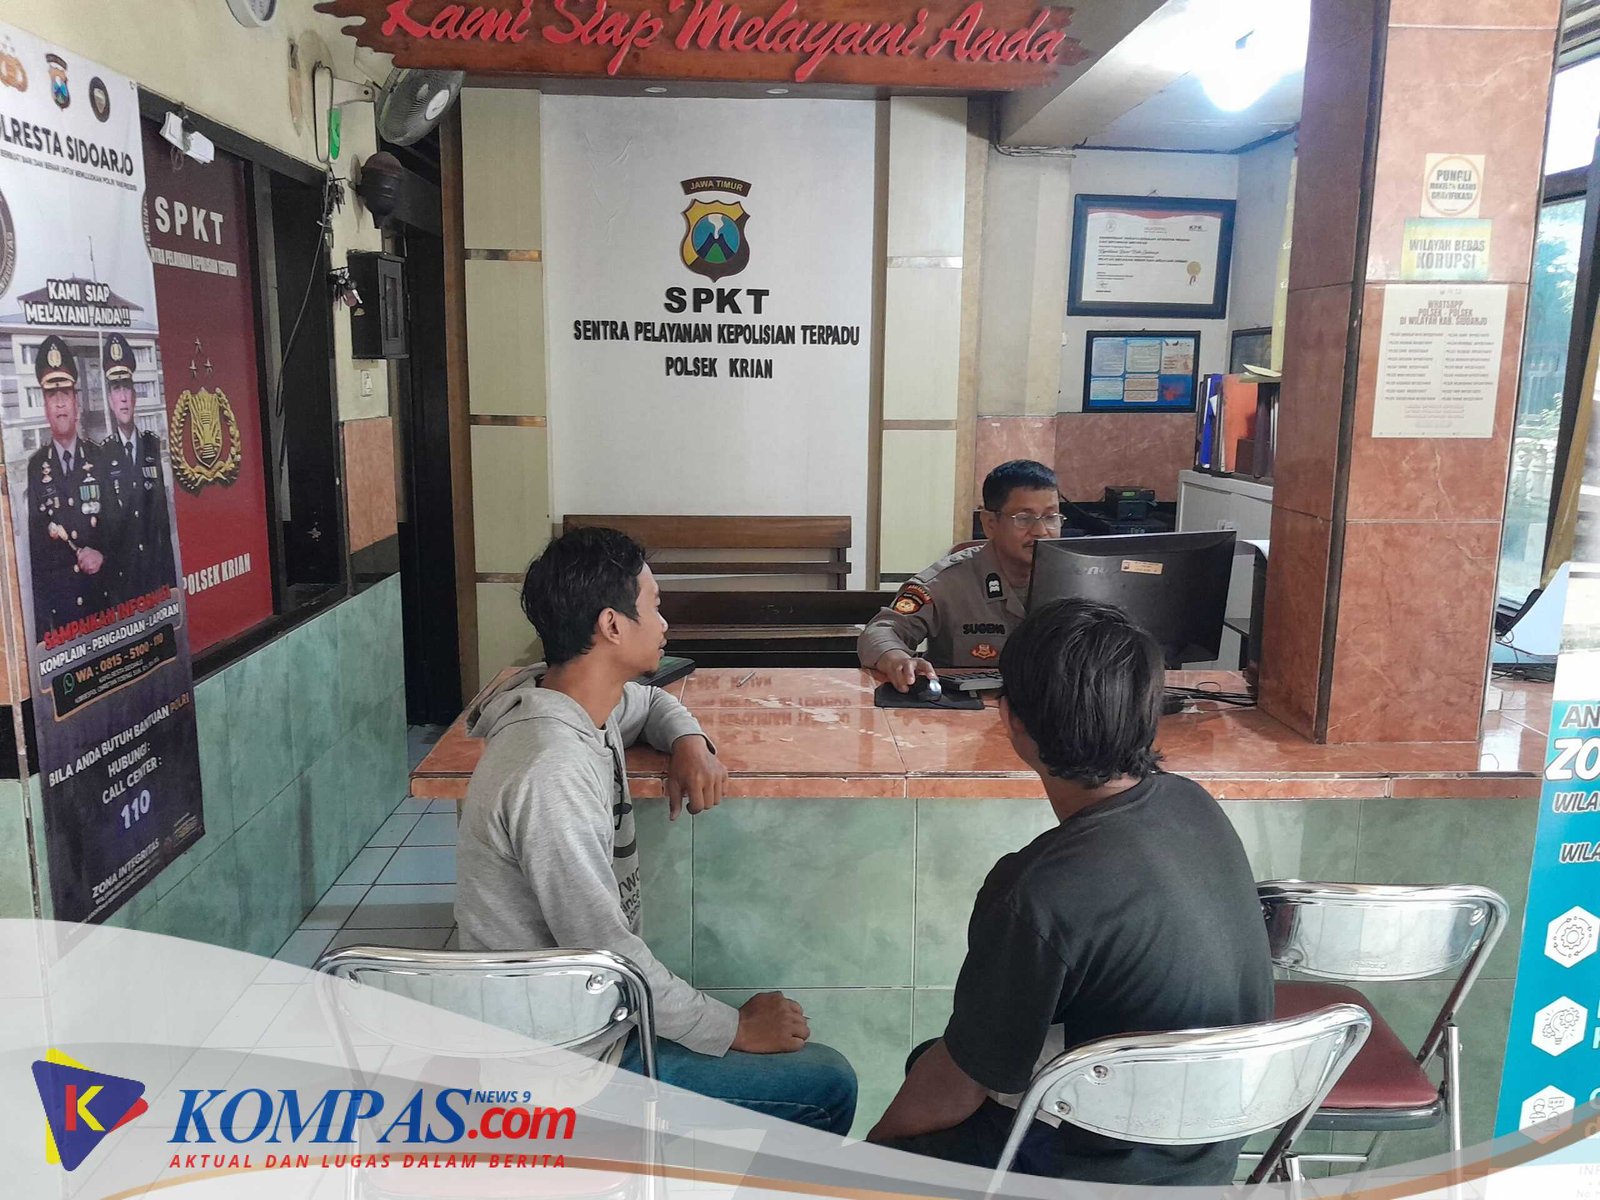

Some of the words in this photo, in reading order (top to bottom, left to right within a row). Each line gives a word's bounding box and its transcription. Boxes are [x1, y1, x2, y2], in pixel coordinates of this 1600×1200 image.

[669, 0, 929, 82] Melayani
[925, 2, 1066, 63] Anda
[0, 113, 64, 158] LRESTA
[65, 135, 135, 177] SIDOARJO
[690, 180, 714, 190] JAWA
[716, 180, 744, 192] TIMUR
[154, 195, 224, 246] SPKT
[1409, 239, 1452, 252] WILAYAH
[1454, 240, 1486, 252] BEBAS
[1416, 252, 1477, 269] KORUPSI
[47, 280, 81, 300] KAMI
[85, 284, 111, 302] SIAP
[664, 286, 770, 315] SPKT
[25, 302, 90, 325] MELAYANI
[93, 306, 131, 327] ANDA!!!
[573, 319, 630, 341] SENTRA
[634, 321, 713, 344] PELAYANAN
[717, 323, 796, 345] KEPOLISIAN
[801, 325, 860, 346] TERPADU
[665, 356, 718, 378] POLSEK
[729, 358, 773, 379] KRIAN
[221, 552, 251, 581] KRIAN
[40, 643, 87, 676] KOMPLAIN
[92, 619, 146, 651] PENGADUAN
[148, 602, 179, 627] LAPORAN
[43, 607, 118, 650] SAMPAIKAN
[75, 666, 95, 683] WA
[100, 653, 123, 672] 0815
[1561, 704, 1600, 729] AN
[48, 763, 75, 787] BILA
[75, 747, 102, 773] ANDA
[100, 728, 134, 756] BUTUH
[133, 705, 170, 737] BANTUAN
[1544, 737, 1600, 781] ZO
[102, 779, 127, 804] CALL
[126, 756, 158, 788] CENTER
[120, 789, 151, 829] 110
[1553, 791, 1600, 814] WILA
[92, 873, 119, 899] ZONA
[118, 838, 160, 878] INTEGRITAS
